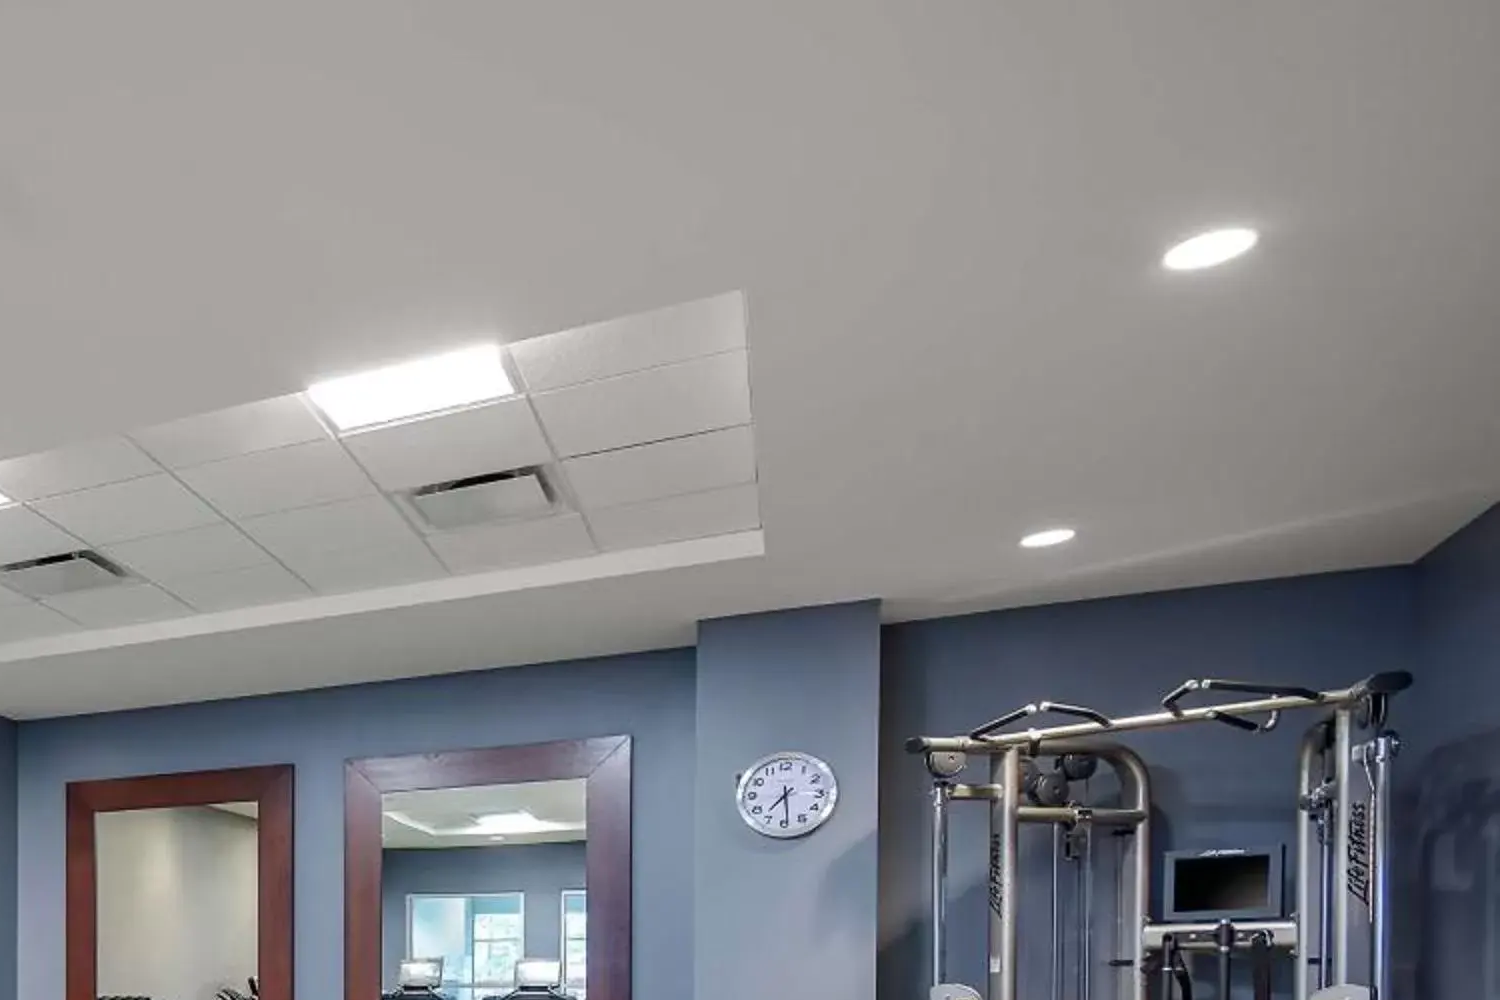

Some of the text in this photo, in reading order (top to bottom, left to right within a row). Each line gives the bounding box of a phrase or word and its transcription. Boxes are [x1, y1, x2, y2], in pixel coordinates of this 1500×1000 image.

[779, 761, 793, 771] 12
[810, 773, 821, 784] 2
[764, 815, 773, 825] 7
